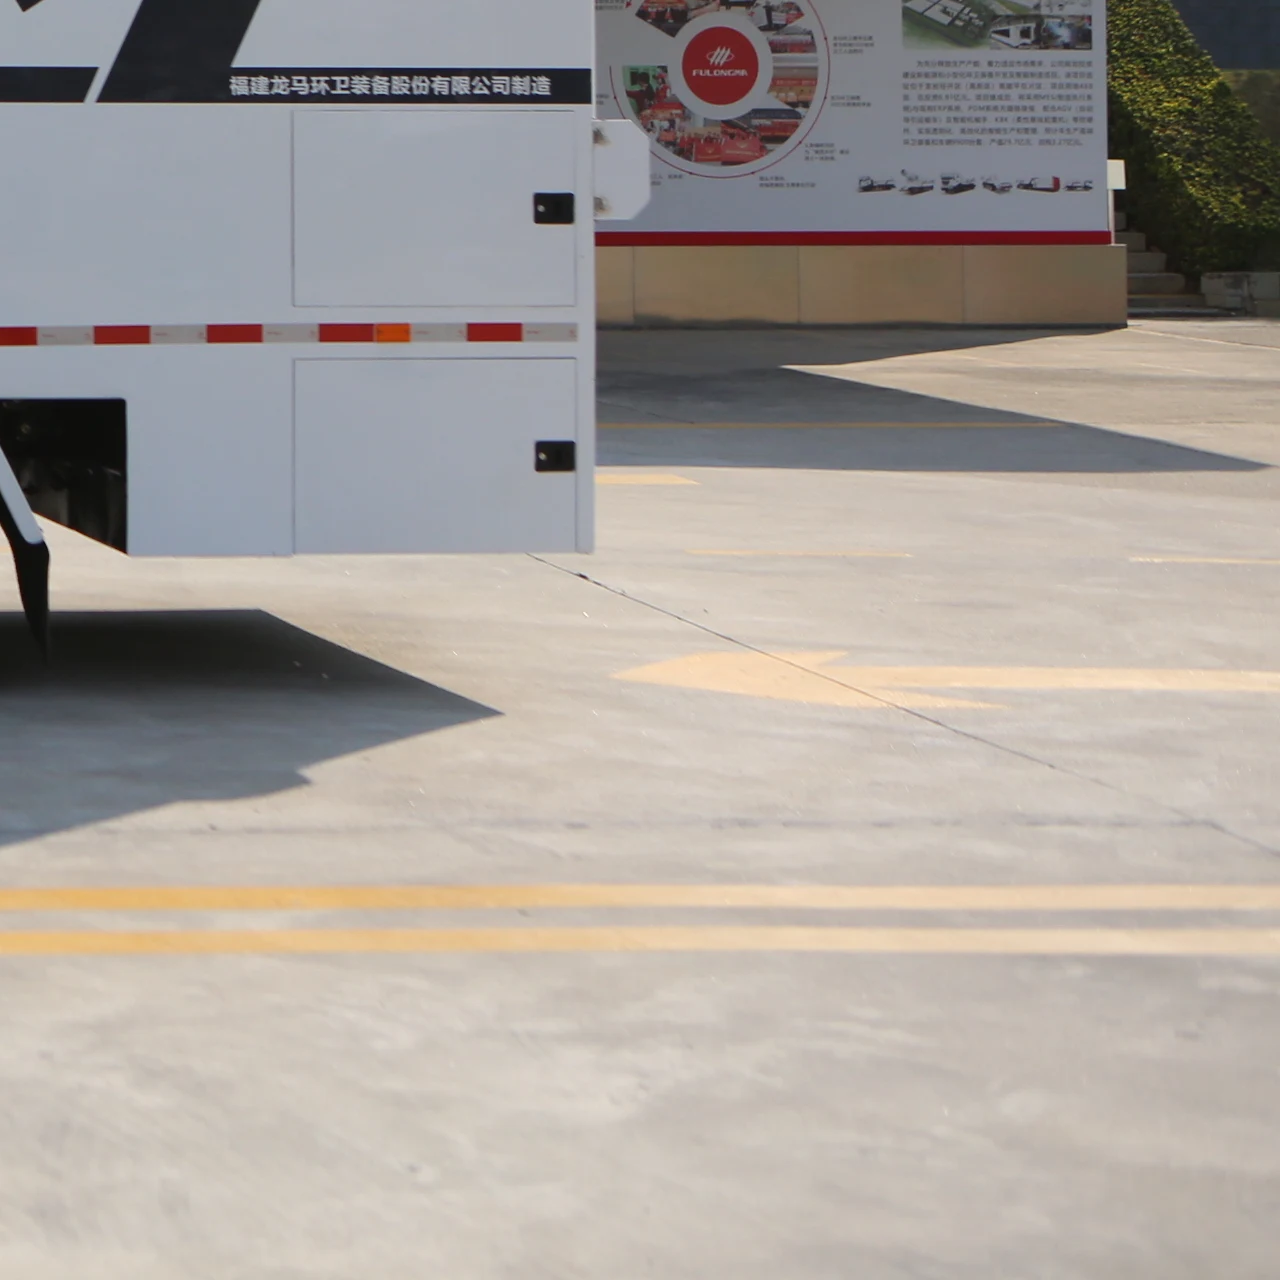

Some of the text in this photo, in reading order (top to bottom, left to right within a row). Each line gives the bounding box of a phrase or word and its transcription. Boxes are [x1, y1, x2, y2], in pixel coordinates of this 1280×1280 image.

[229, 75, 551, 96] 福建龙马环卫装备股份有限公司制造
